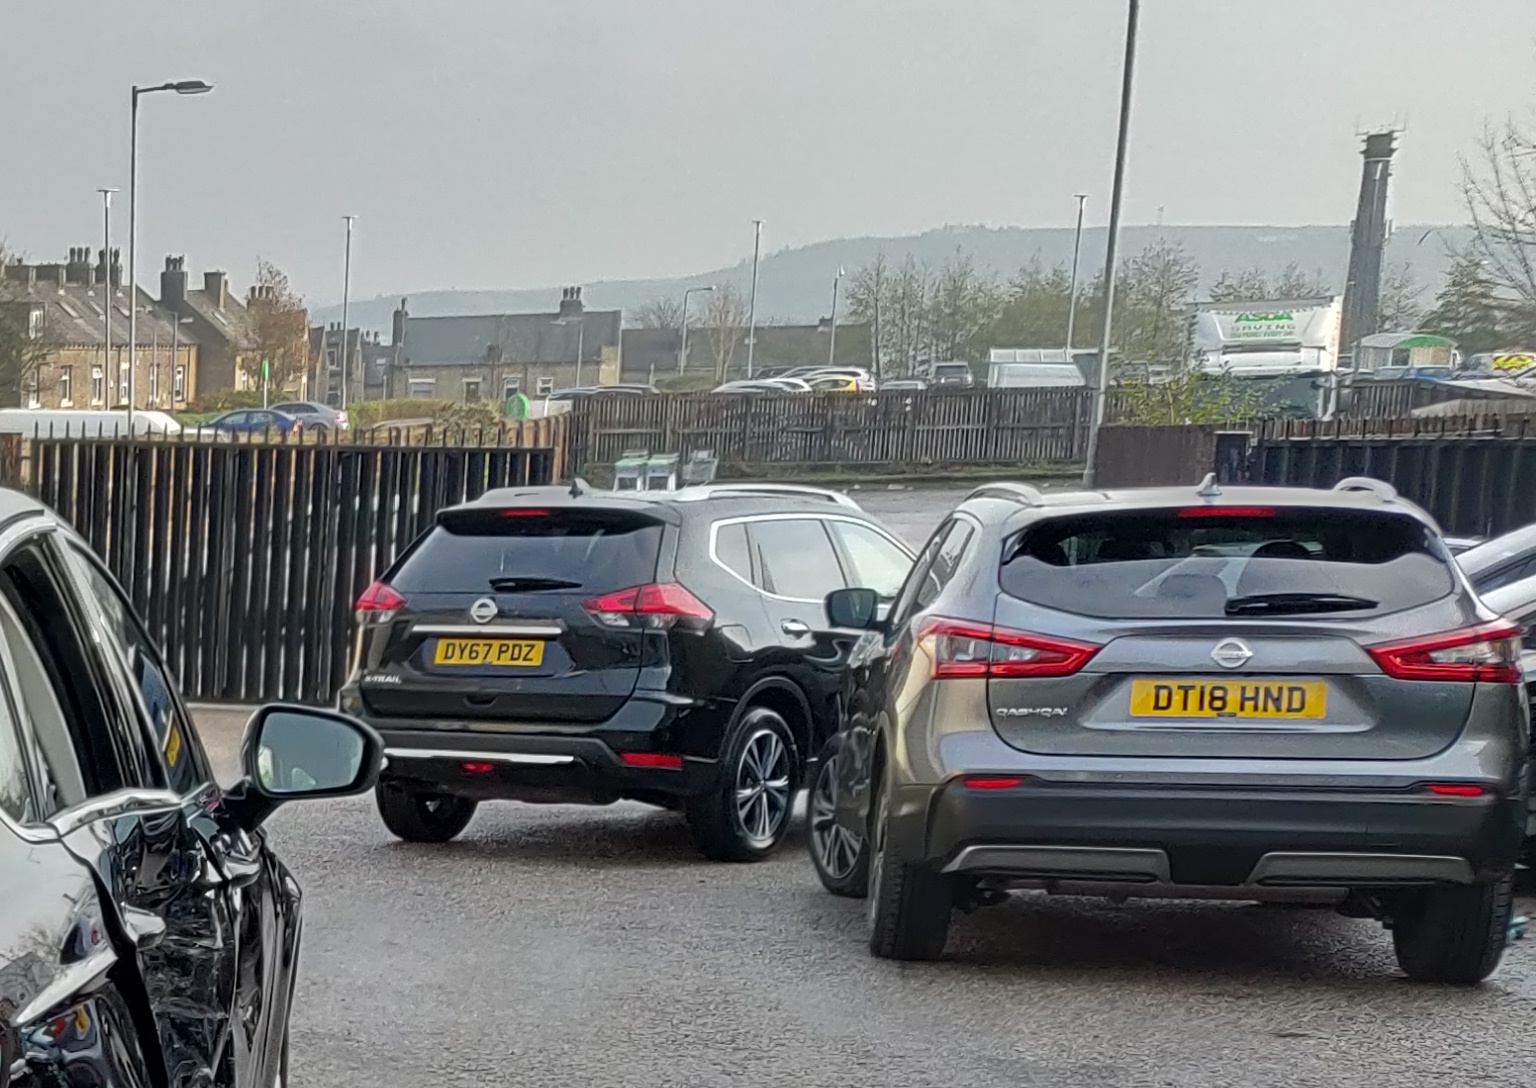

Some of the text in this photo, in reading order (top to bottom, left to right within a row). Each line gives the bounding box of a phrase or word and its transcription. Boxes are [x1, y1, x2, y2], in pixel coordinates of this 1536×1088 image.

[1234, 312, 1294, 323] ASDA
[443, 642, 537, 662] DY67 PDZ
[1152, 684, 1307, 713] DT18 HND
